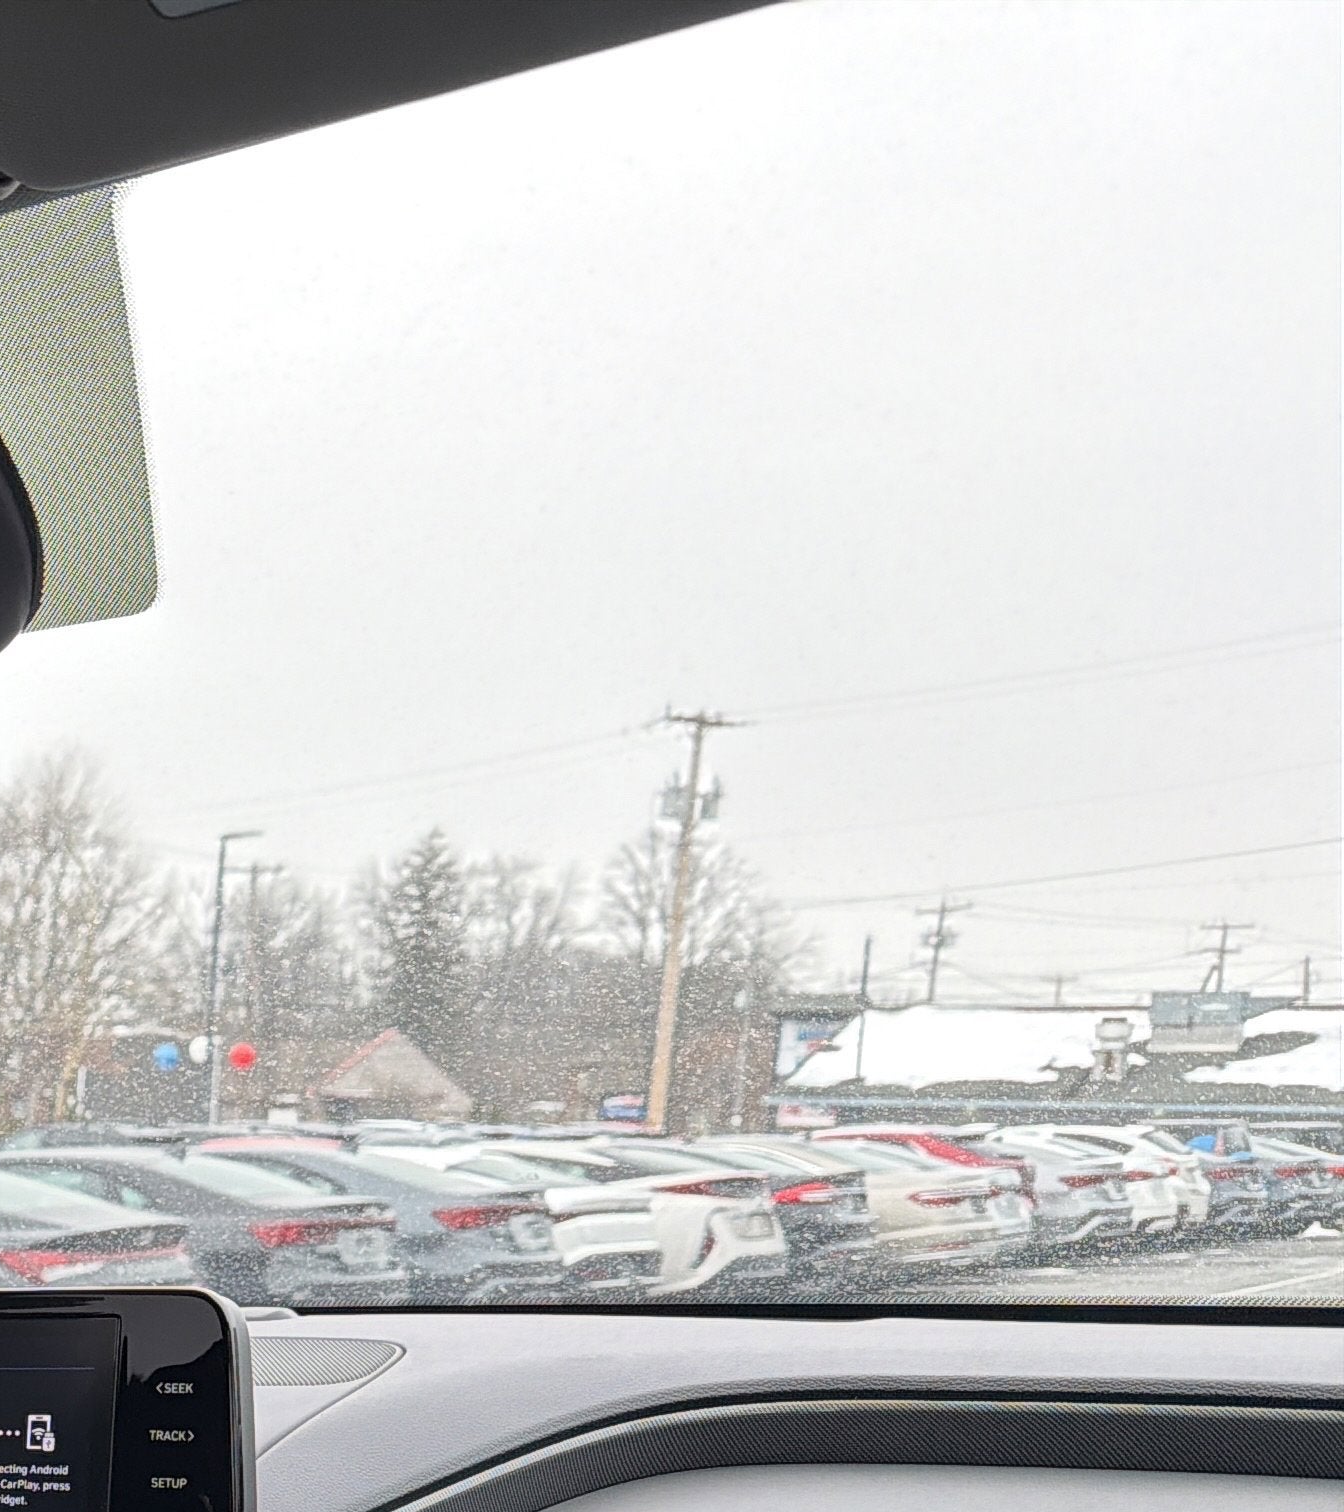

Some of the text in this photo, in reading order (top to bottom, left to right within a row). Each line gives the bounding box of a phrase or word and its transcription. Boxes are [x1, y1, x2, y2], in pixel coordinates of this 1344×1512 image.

[163, 1382, 194, 1394] SEEK
[149, 1429, 186, 1441] TRACK
[29, 1464, 69, 1476] Android
[42, 1481, 71, 1492] press
[150, 1477, 188, 1489] SETUP
